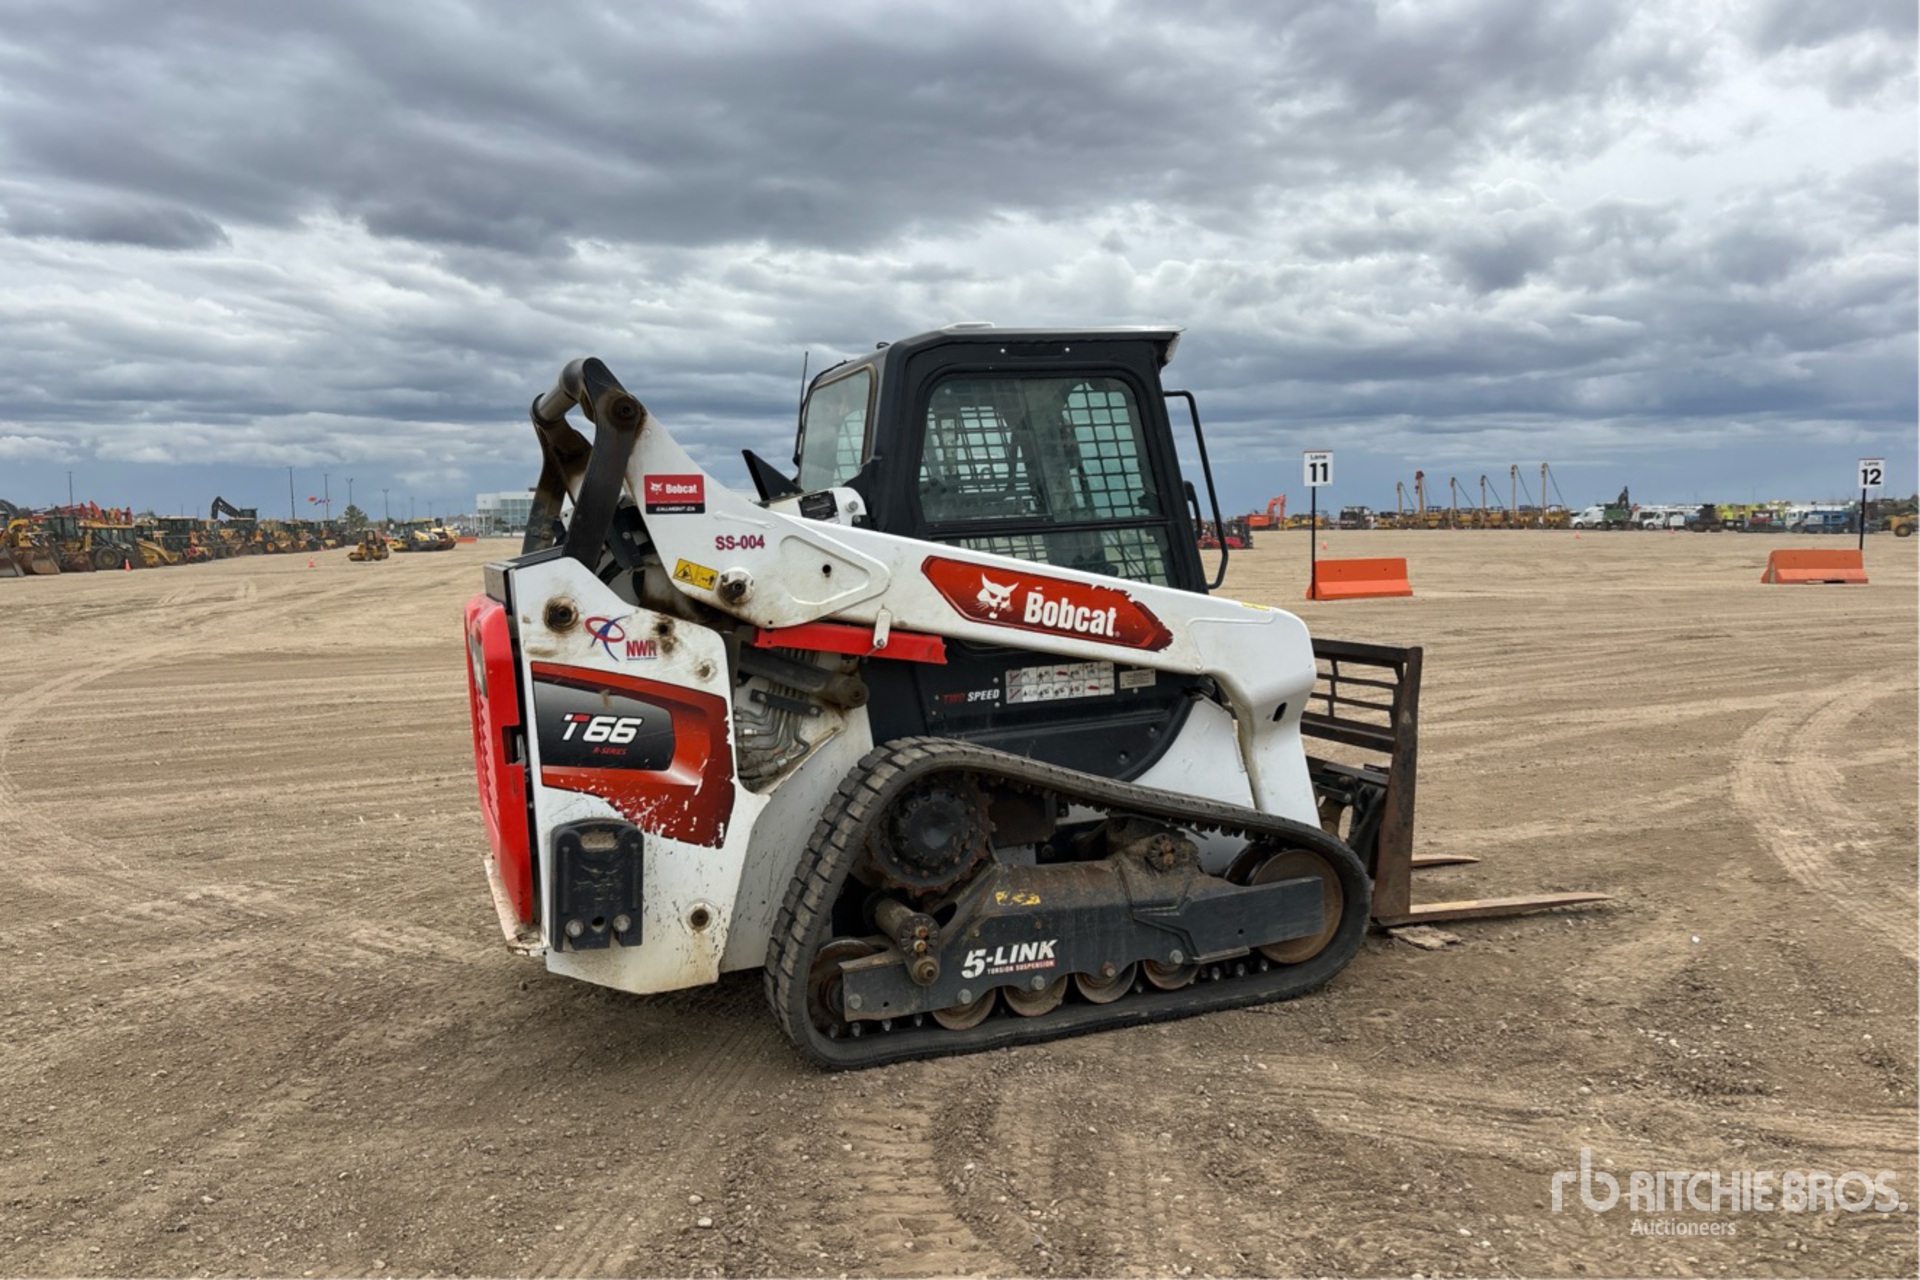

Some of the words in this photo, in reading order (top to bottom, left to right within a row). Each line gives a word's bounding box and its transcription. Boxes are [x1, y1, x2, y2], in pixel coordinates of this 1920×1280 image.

[1309, 462, 1328, 482] 11
[1861, 468, 1882, 485] 12
[665, 483, 698, 495] Bobcat
[715, 534, 765, 550] SS-004
[1023, 591, 1117, 637] Bobcat
[626, 640, 657, 657] NWR
[967, 689, 1000, 702] SPEED
[562, 713, 643, 744] T66
[961, 939, 1058, 979] 5-LINK
[987, 965, 1014, 975] TORSION
[1015, 960, 1056, 971] SUSPENSION
